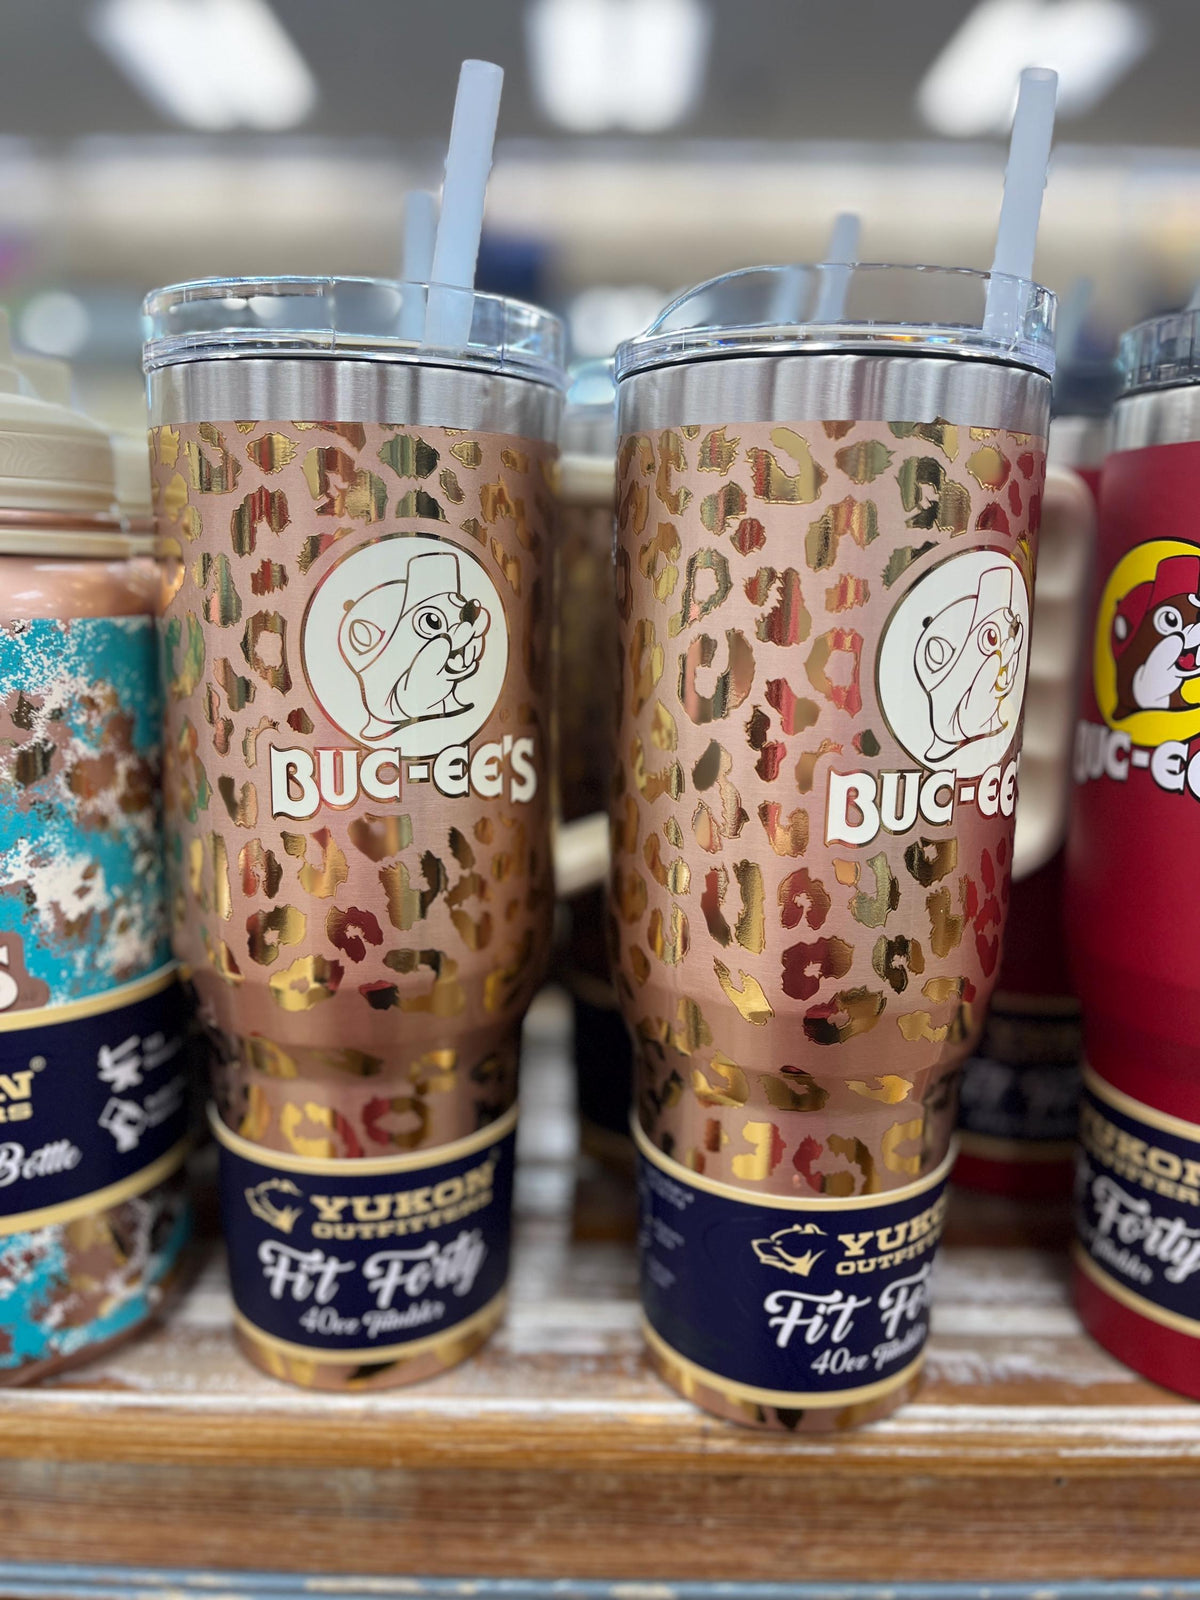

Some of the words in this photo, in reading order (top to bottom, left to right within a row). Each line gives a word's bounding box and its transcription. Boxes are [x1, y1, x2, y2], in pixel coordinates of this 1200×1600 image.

[310, 1160, 496, 1222] YUKON
[258, 1240, 356, 1304] Fit
[362, 1228, 487, 1310] Forty
[764, 1289, 872, 1348] Fit
